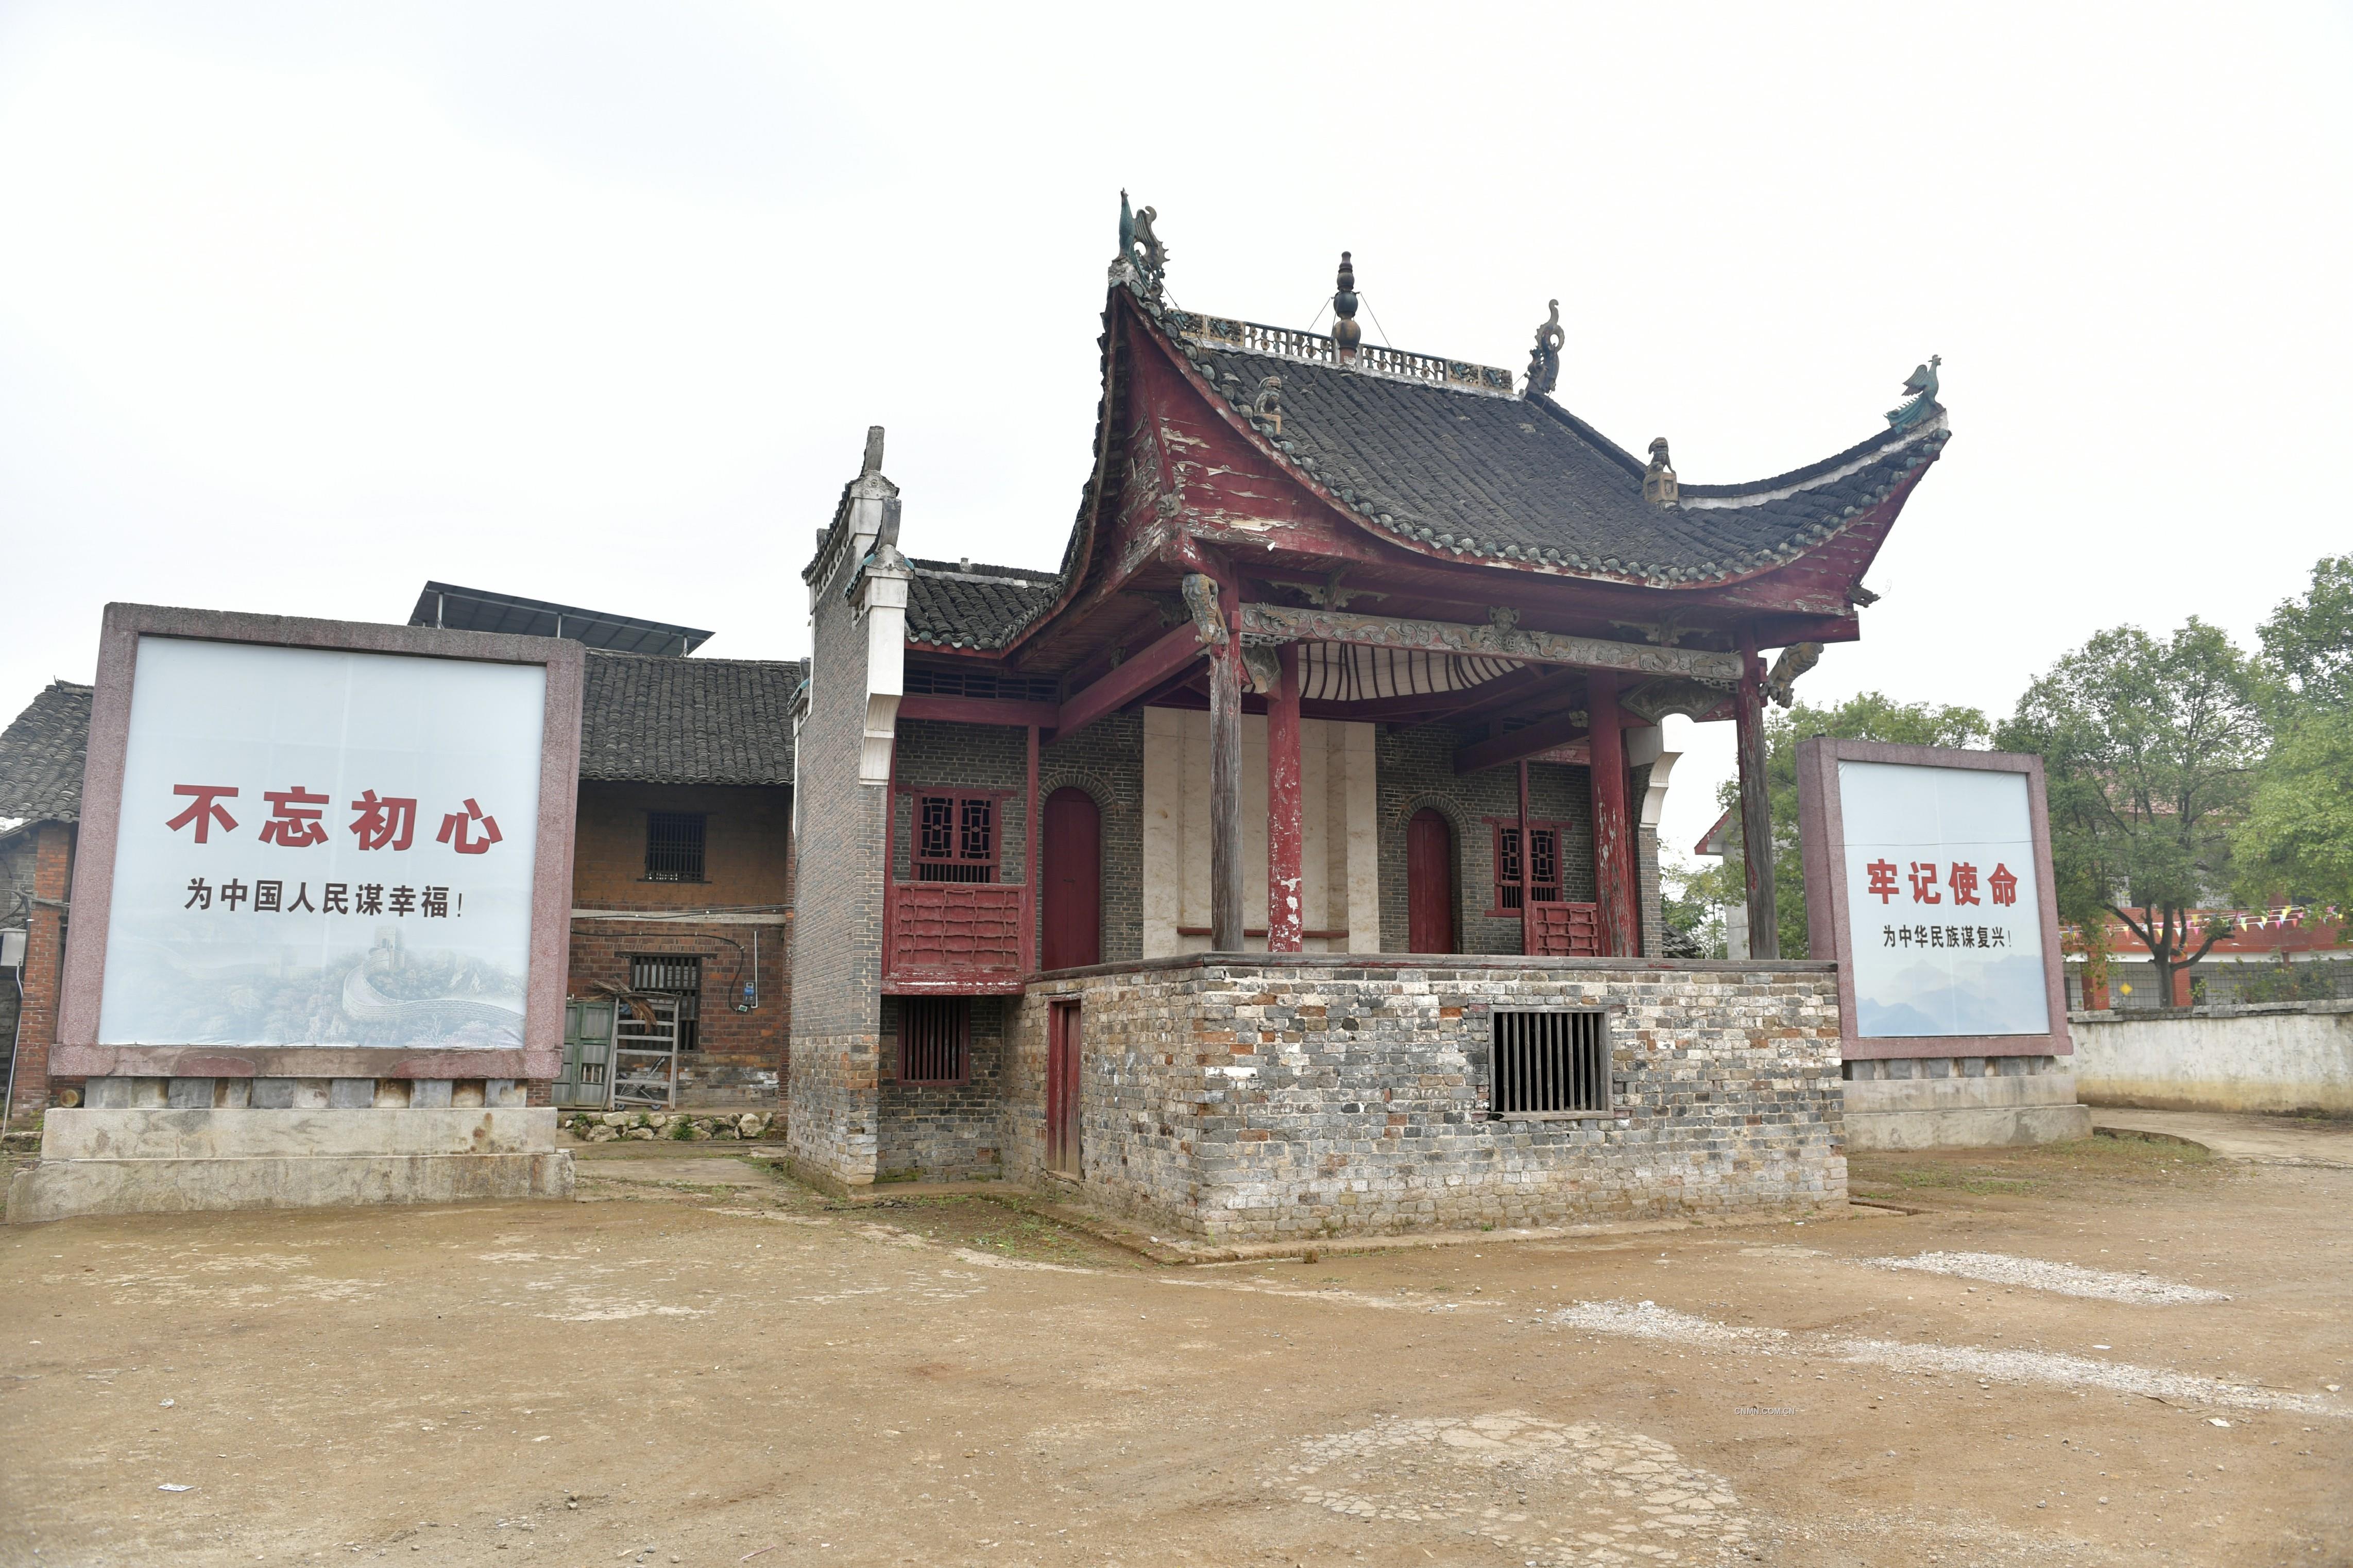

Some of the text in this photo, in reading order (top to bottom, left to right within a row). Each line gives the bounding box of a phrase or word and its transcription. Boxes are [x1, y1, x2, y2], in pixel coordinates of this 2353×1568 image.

[166, 784, 503, 855] 不忘初心
[1867, 858, 2018, 907] 牢记使命
